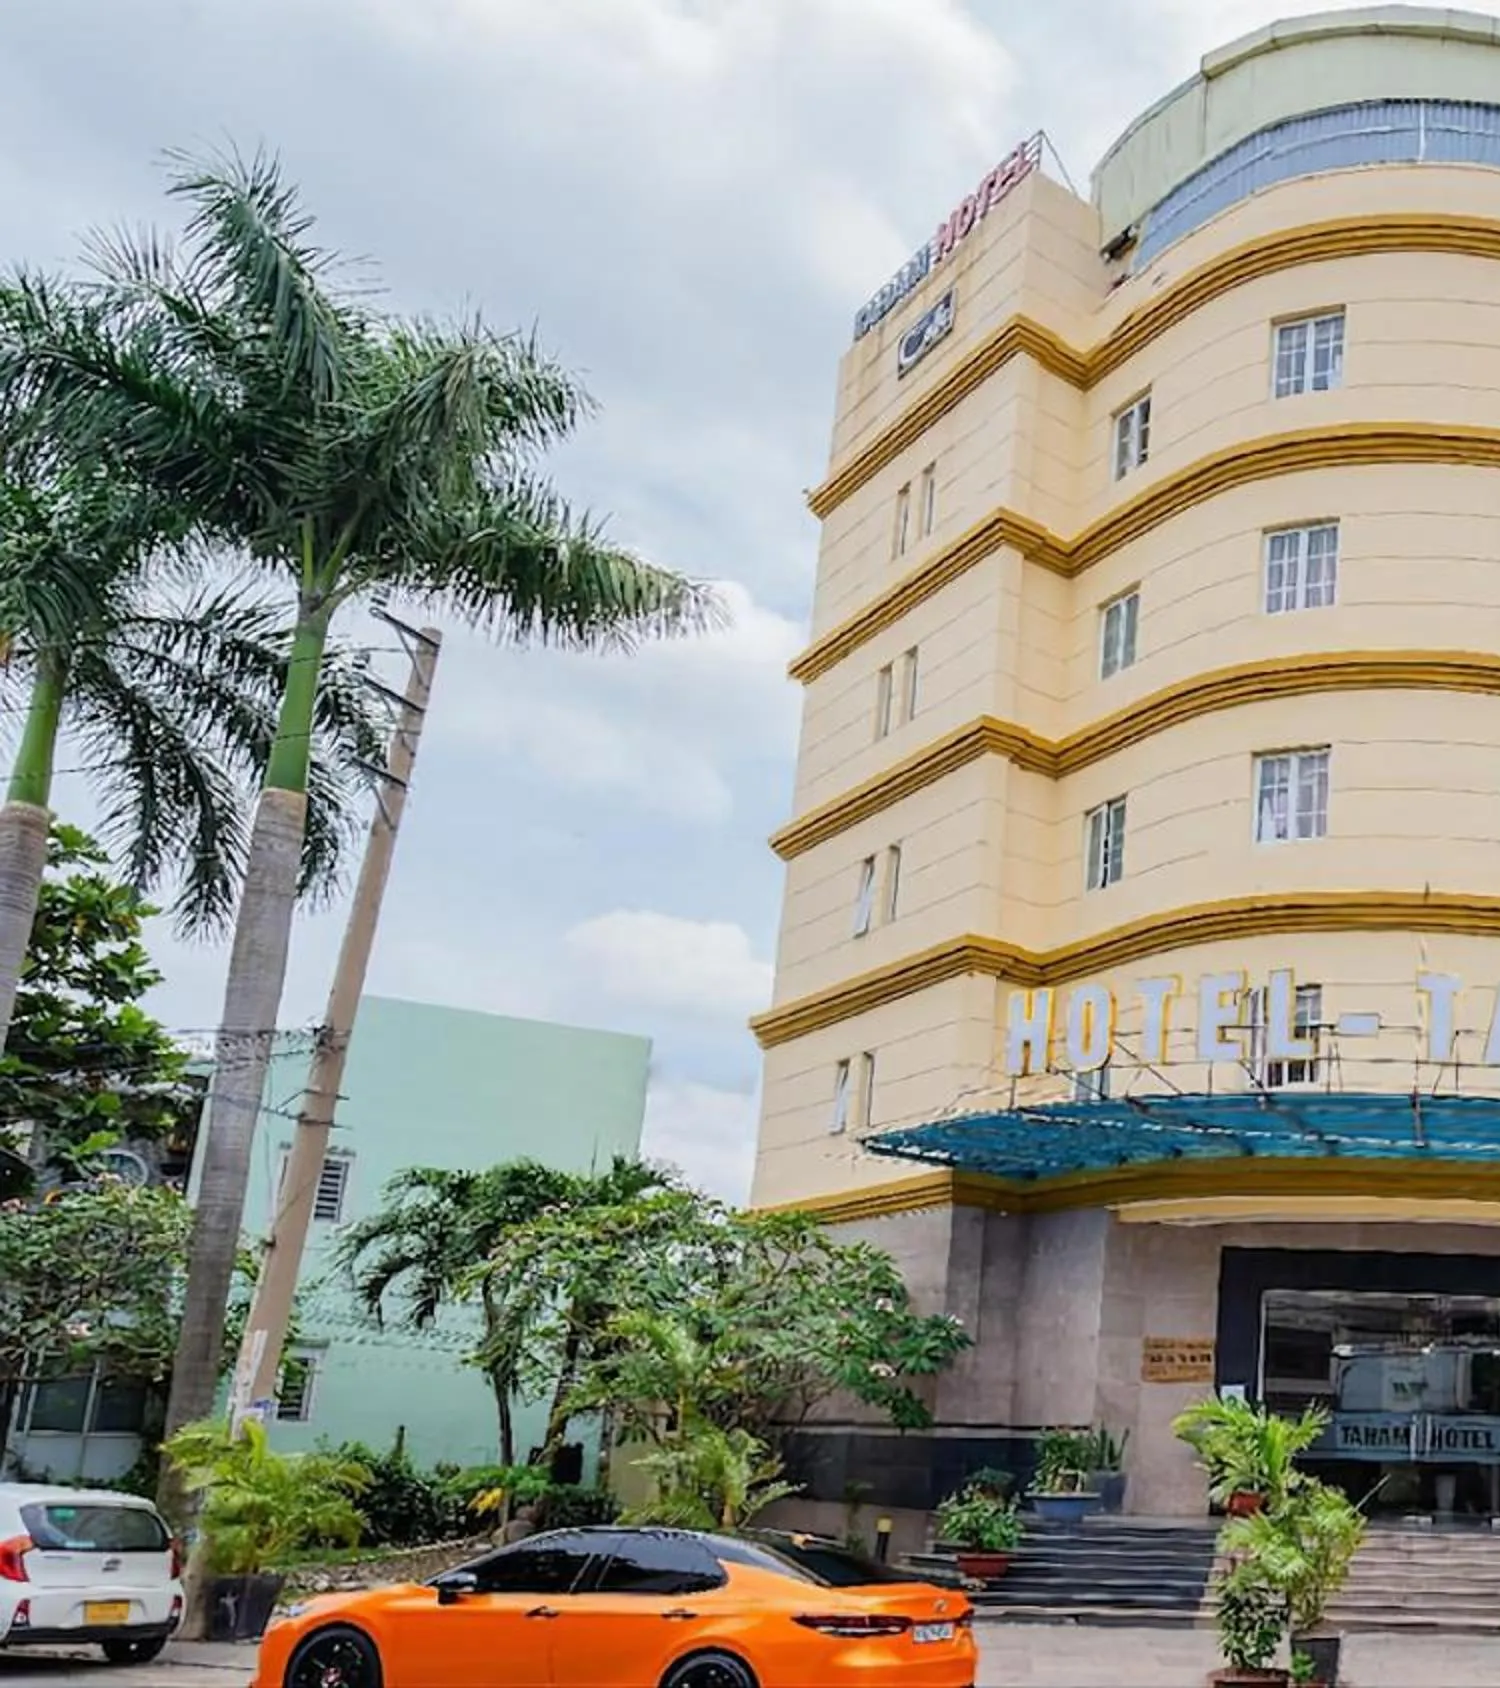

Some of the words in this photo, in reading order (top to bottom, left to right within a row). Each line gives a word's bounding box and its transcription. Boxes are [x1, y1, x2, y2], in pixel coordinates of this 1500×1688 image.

[932, 141, 1033, 263] HOTEL
[1006, 968, 1320, 1077] HOTEL
[1340, 1425, 1417, 1448] TAHAM
[1430, 1428, 1494, 1449] HOTEL
